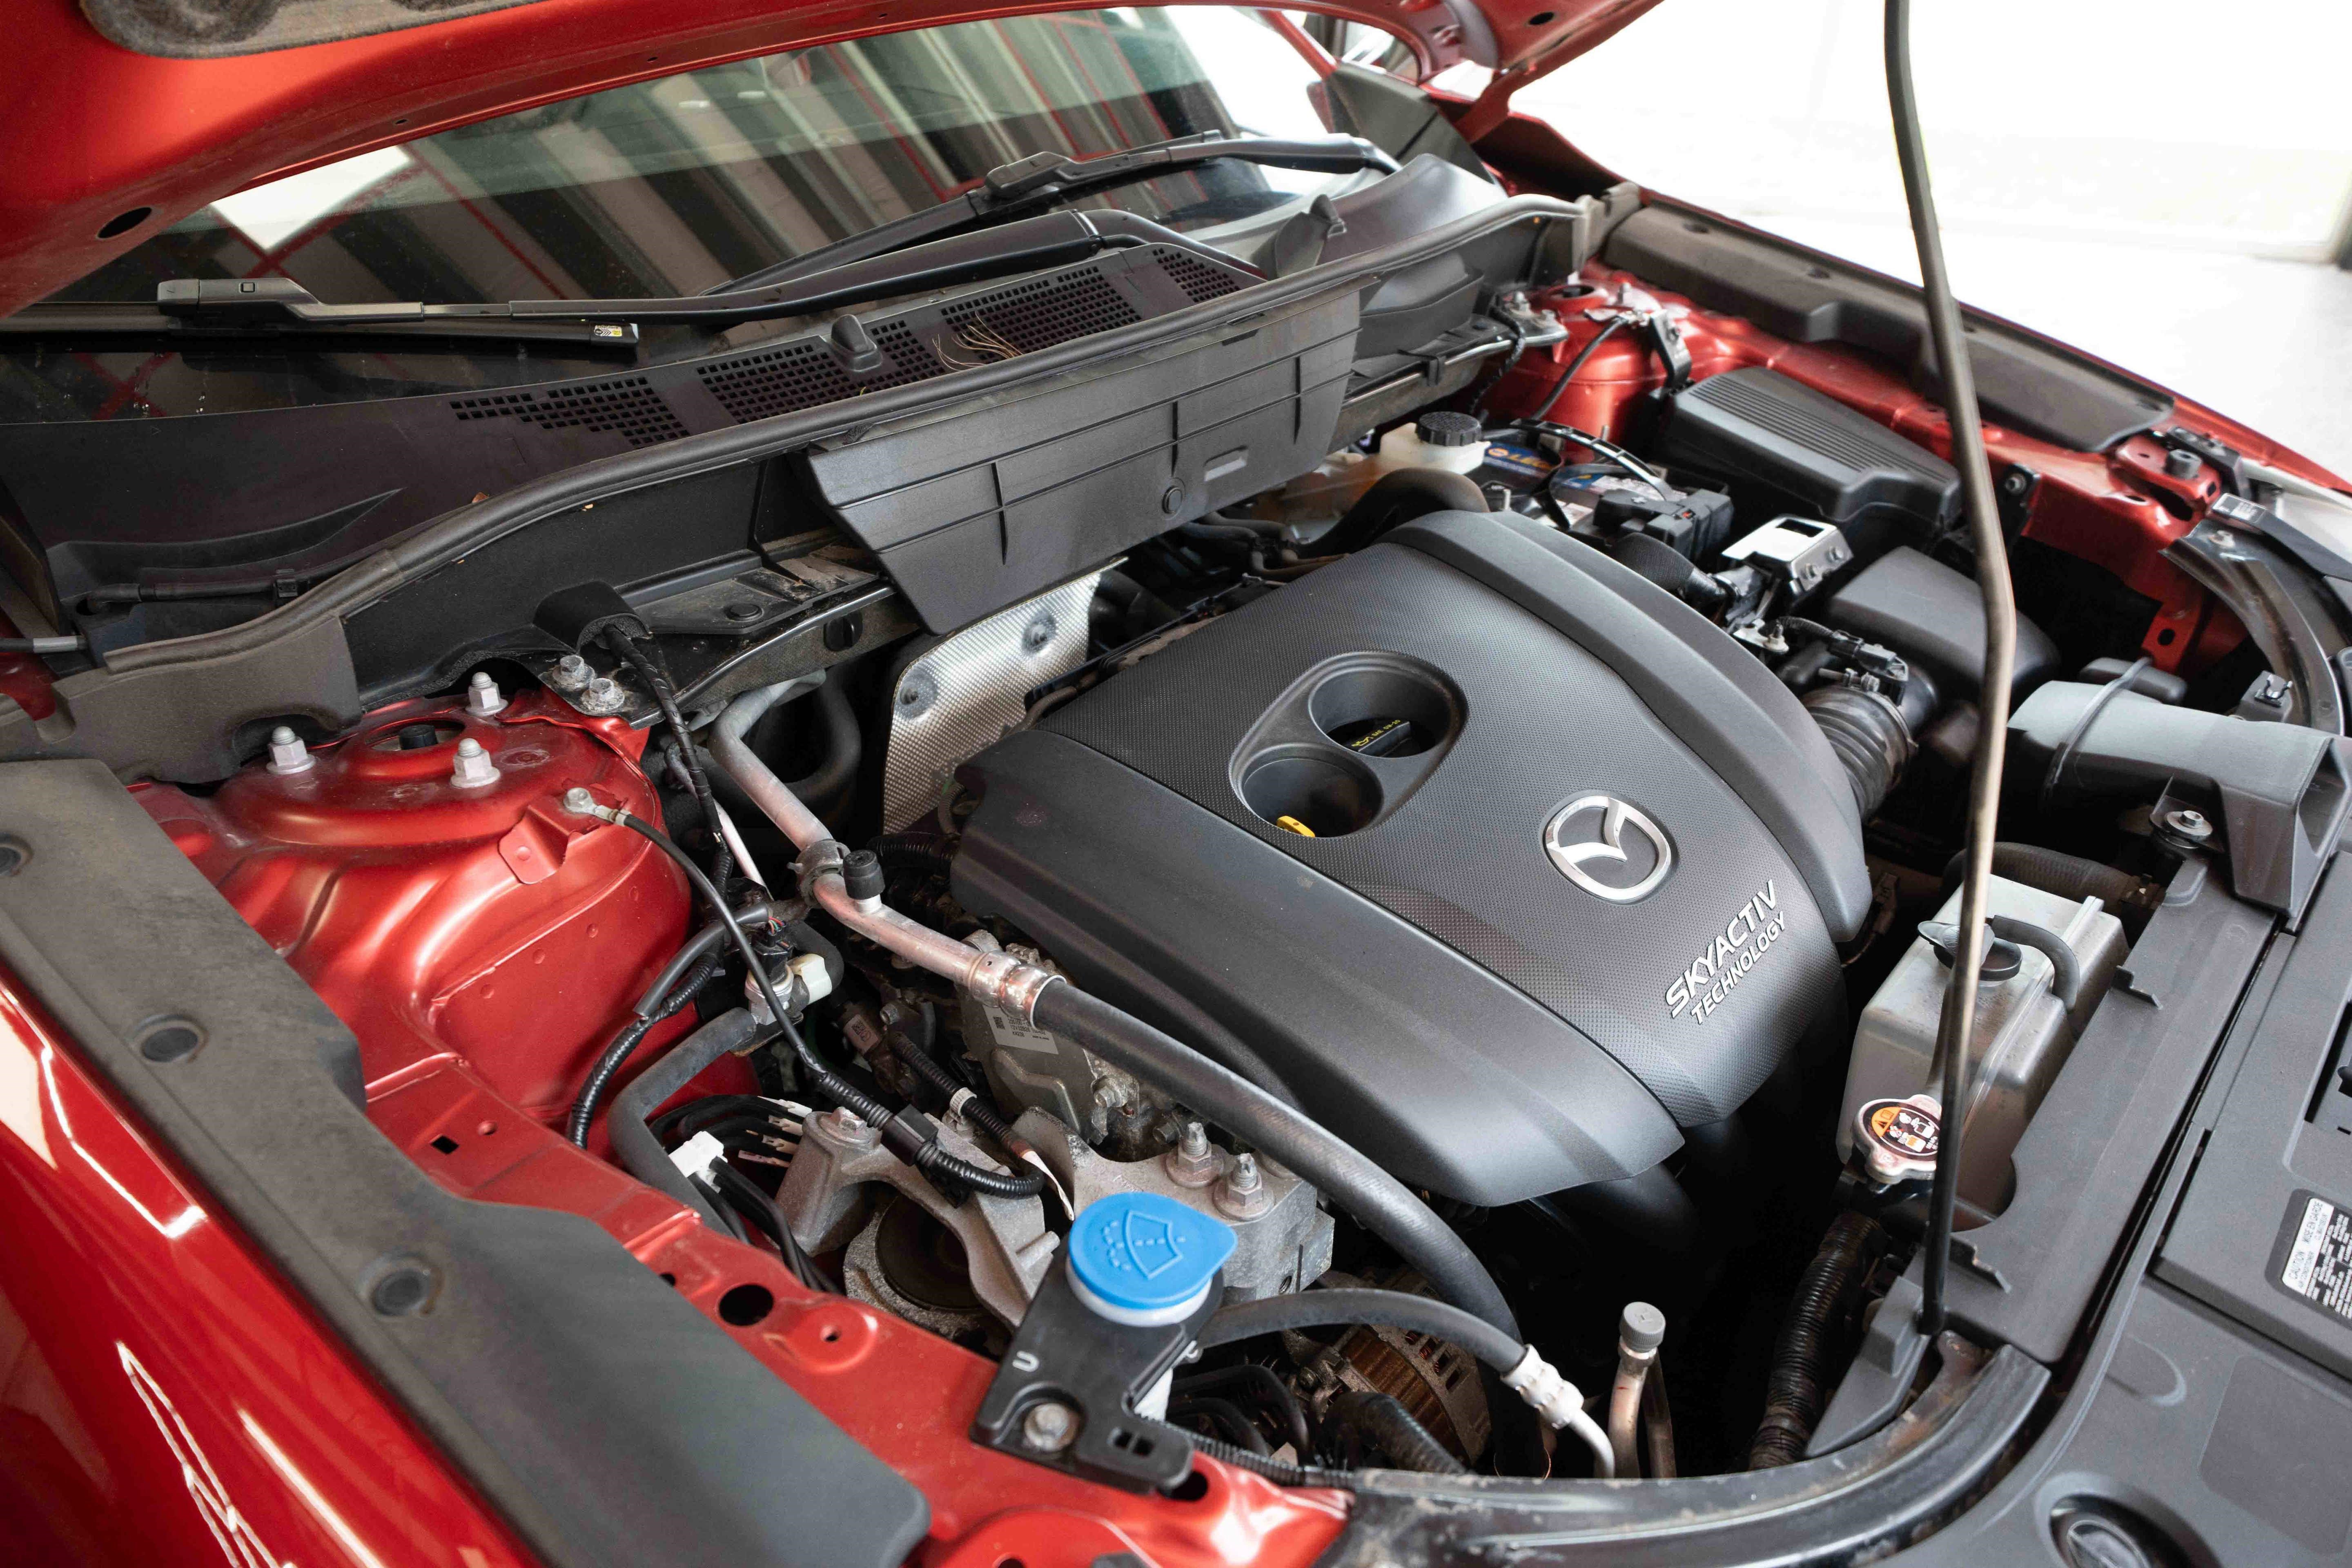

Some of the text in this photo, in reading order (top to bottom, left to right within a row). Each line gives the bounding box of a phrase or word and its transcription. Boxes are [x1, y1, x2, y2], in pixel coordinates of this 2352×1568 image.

[1666, 879, 1777, 1018] SKYACTIV
[1690, 911, 1785, 1025] TECHNOLOGY
[2301, 1201, 2323, 1244] MISE EN GARDE
[2288, 1251, 2305, 1279] CAUTION
